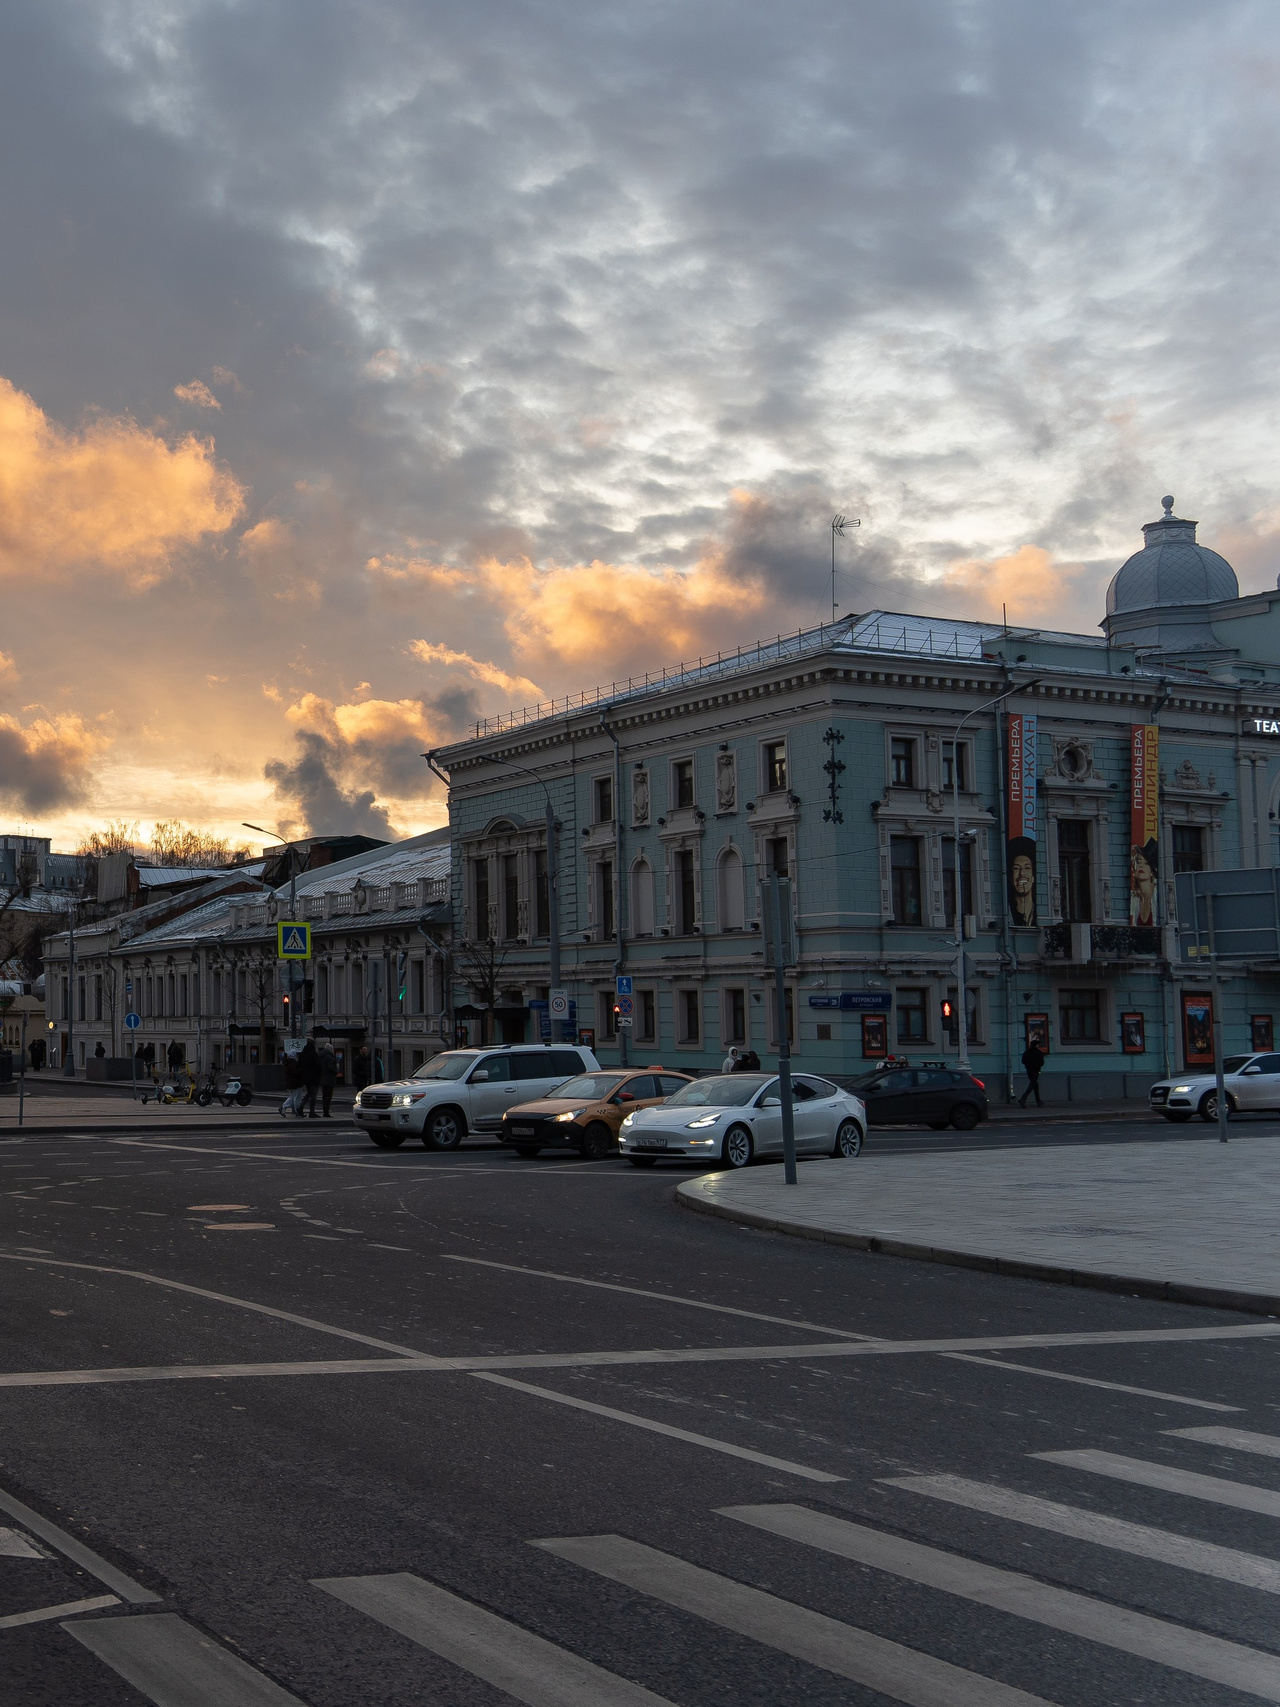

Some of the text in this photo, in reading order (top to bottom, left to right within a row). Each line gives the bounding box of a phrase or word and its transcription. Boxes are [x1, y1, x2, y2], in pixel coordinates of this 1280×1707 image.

[1011, 719, 1020, 801] ПРЕМЬЕРА
[1254, 719, 1280, 733] ТЕА
[1024, 720, 1036, 831] ДОН ЖУАН
[1134, 729, 1143, 808] ПРЕМЬЕРА
[1146, 730, 1158, 831] ЦИЛИНДР
